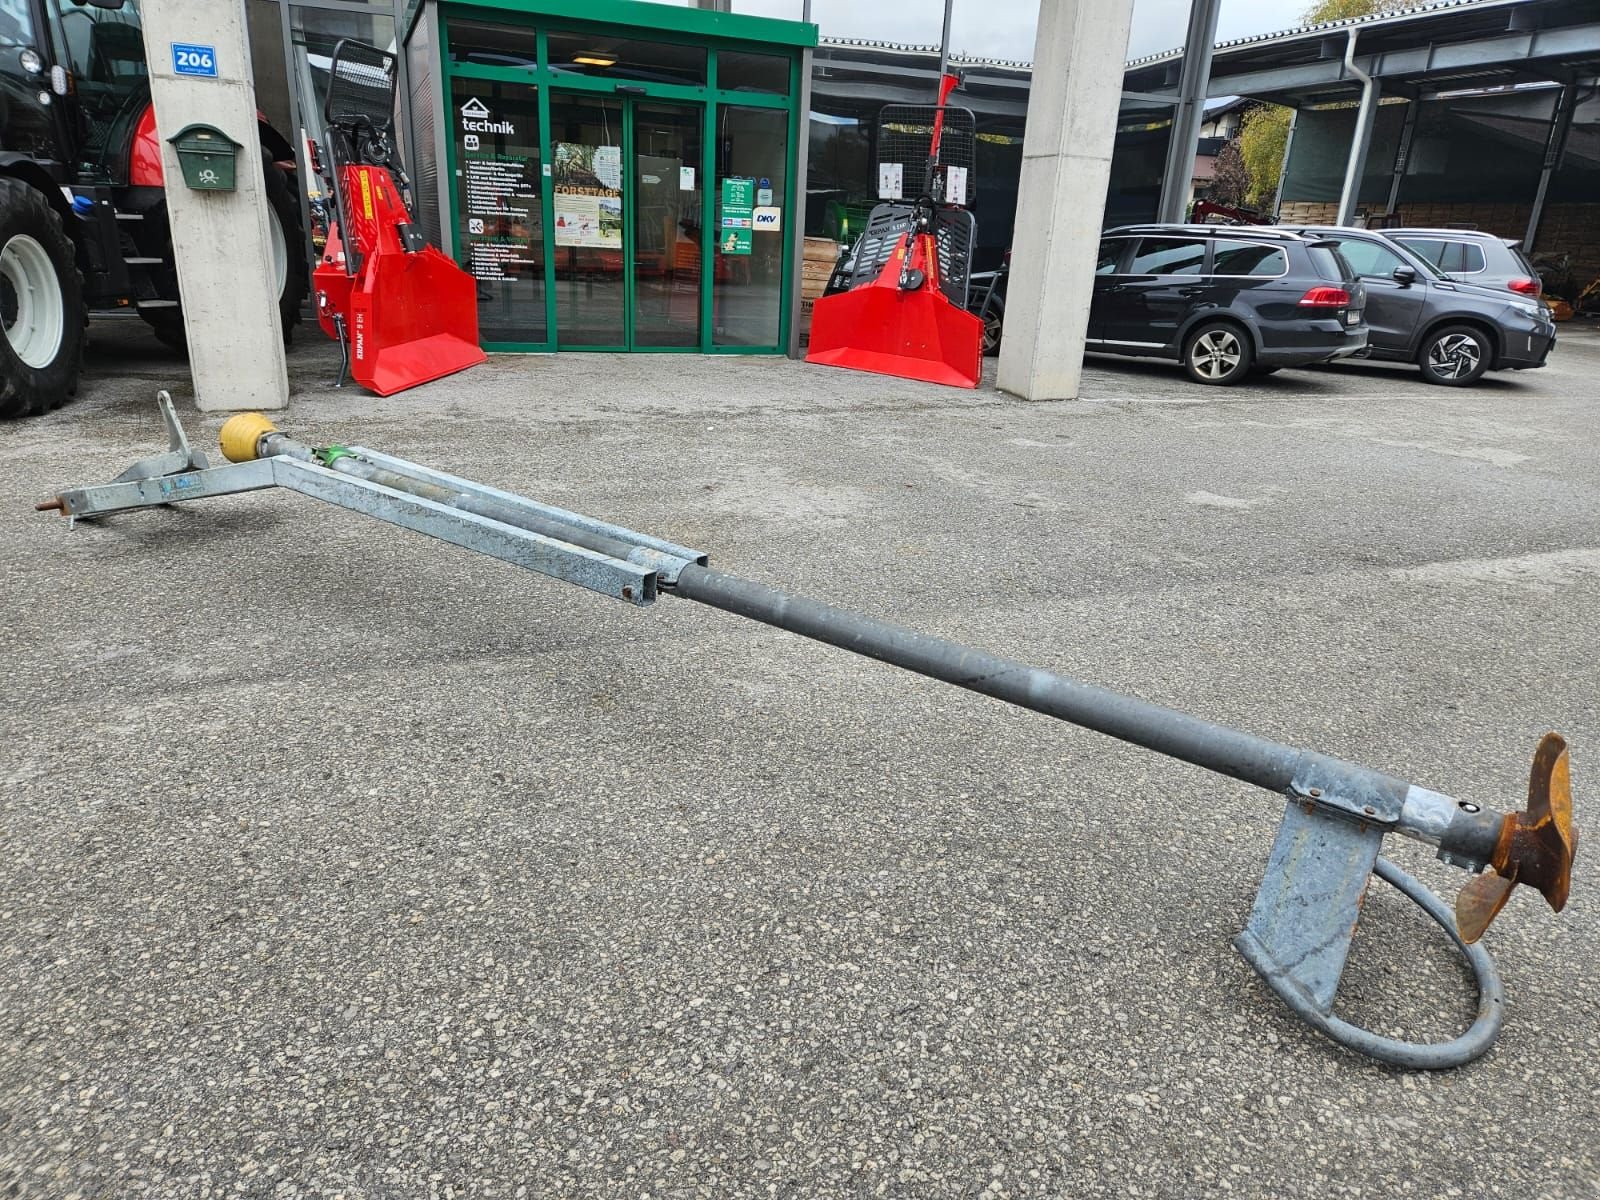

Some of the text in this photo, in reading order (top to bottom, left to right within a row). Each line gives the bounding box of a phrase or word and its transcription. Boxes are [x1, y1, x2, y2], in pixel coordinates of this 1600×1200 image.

[177, 51, 213, 68] 206
[462, 118, 515, 135] technik
[554, 185, 621, 198] FORSTTAGE
[756, 214, 776, 224] DKV
